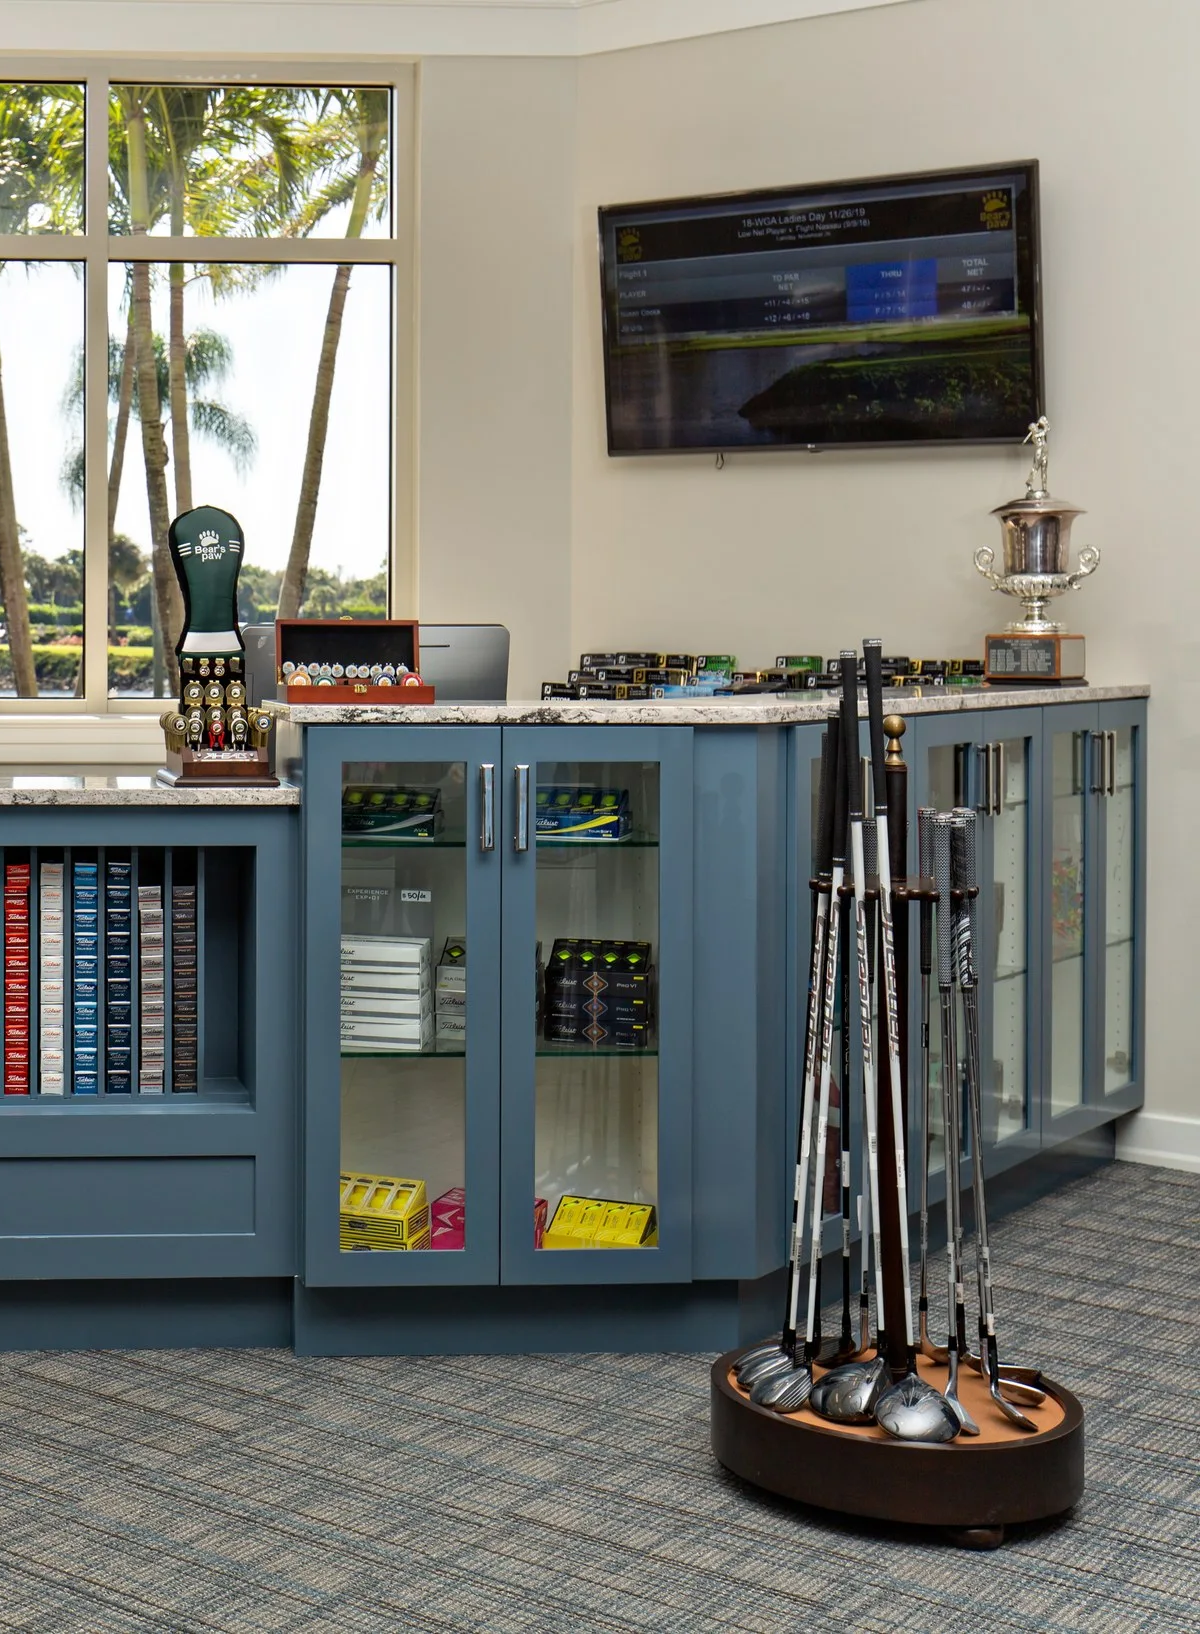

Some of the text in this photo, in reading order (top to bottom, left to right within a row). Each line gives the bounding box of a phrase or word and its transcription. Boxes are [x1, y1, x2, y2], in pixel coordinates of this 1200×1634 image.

[778, 212, 806, 225] Ladies
[809, 211, 826, 223] Day
[962, 258, 989, 266] TOTAL
[967, 268, 985, 276] NET
[195, 544, 226, 555] Bear's
[201, 552, 222, 562] paw
[347, 888, 389, 896] EXPERIENCE
